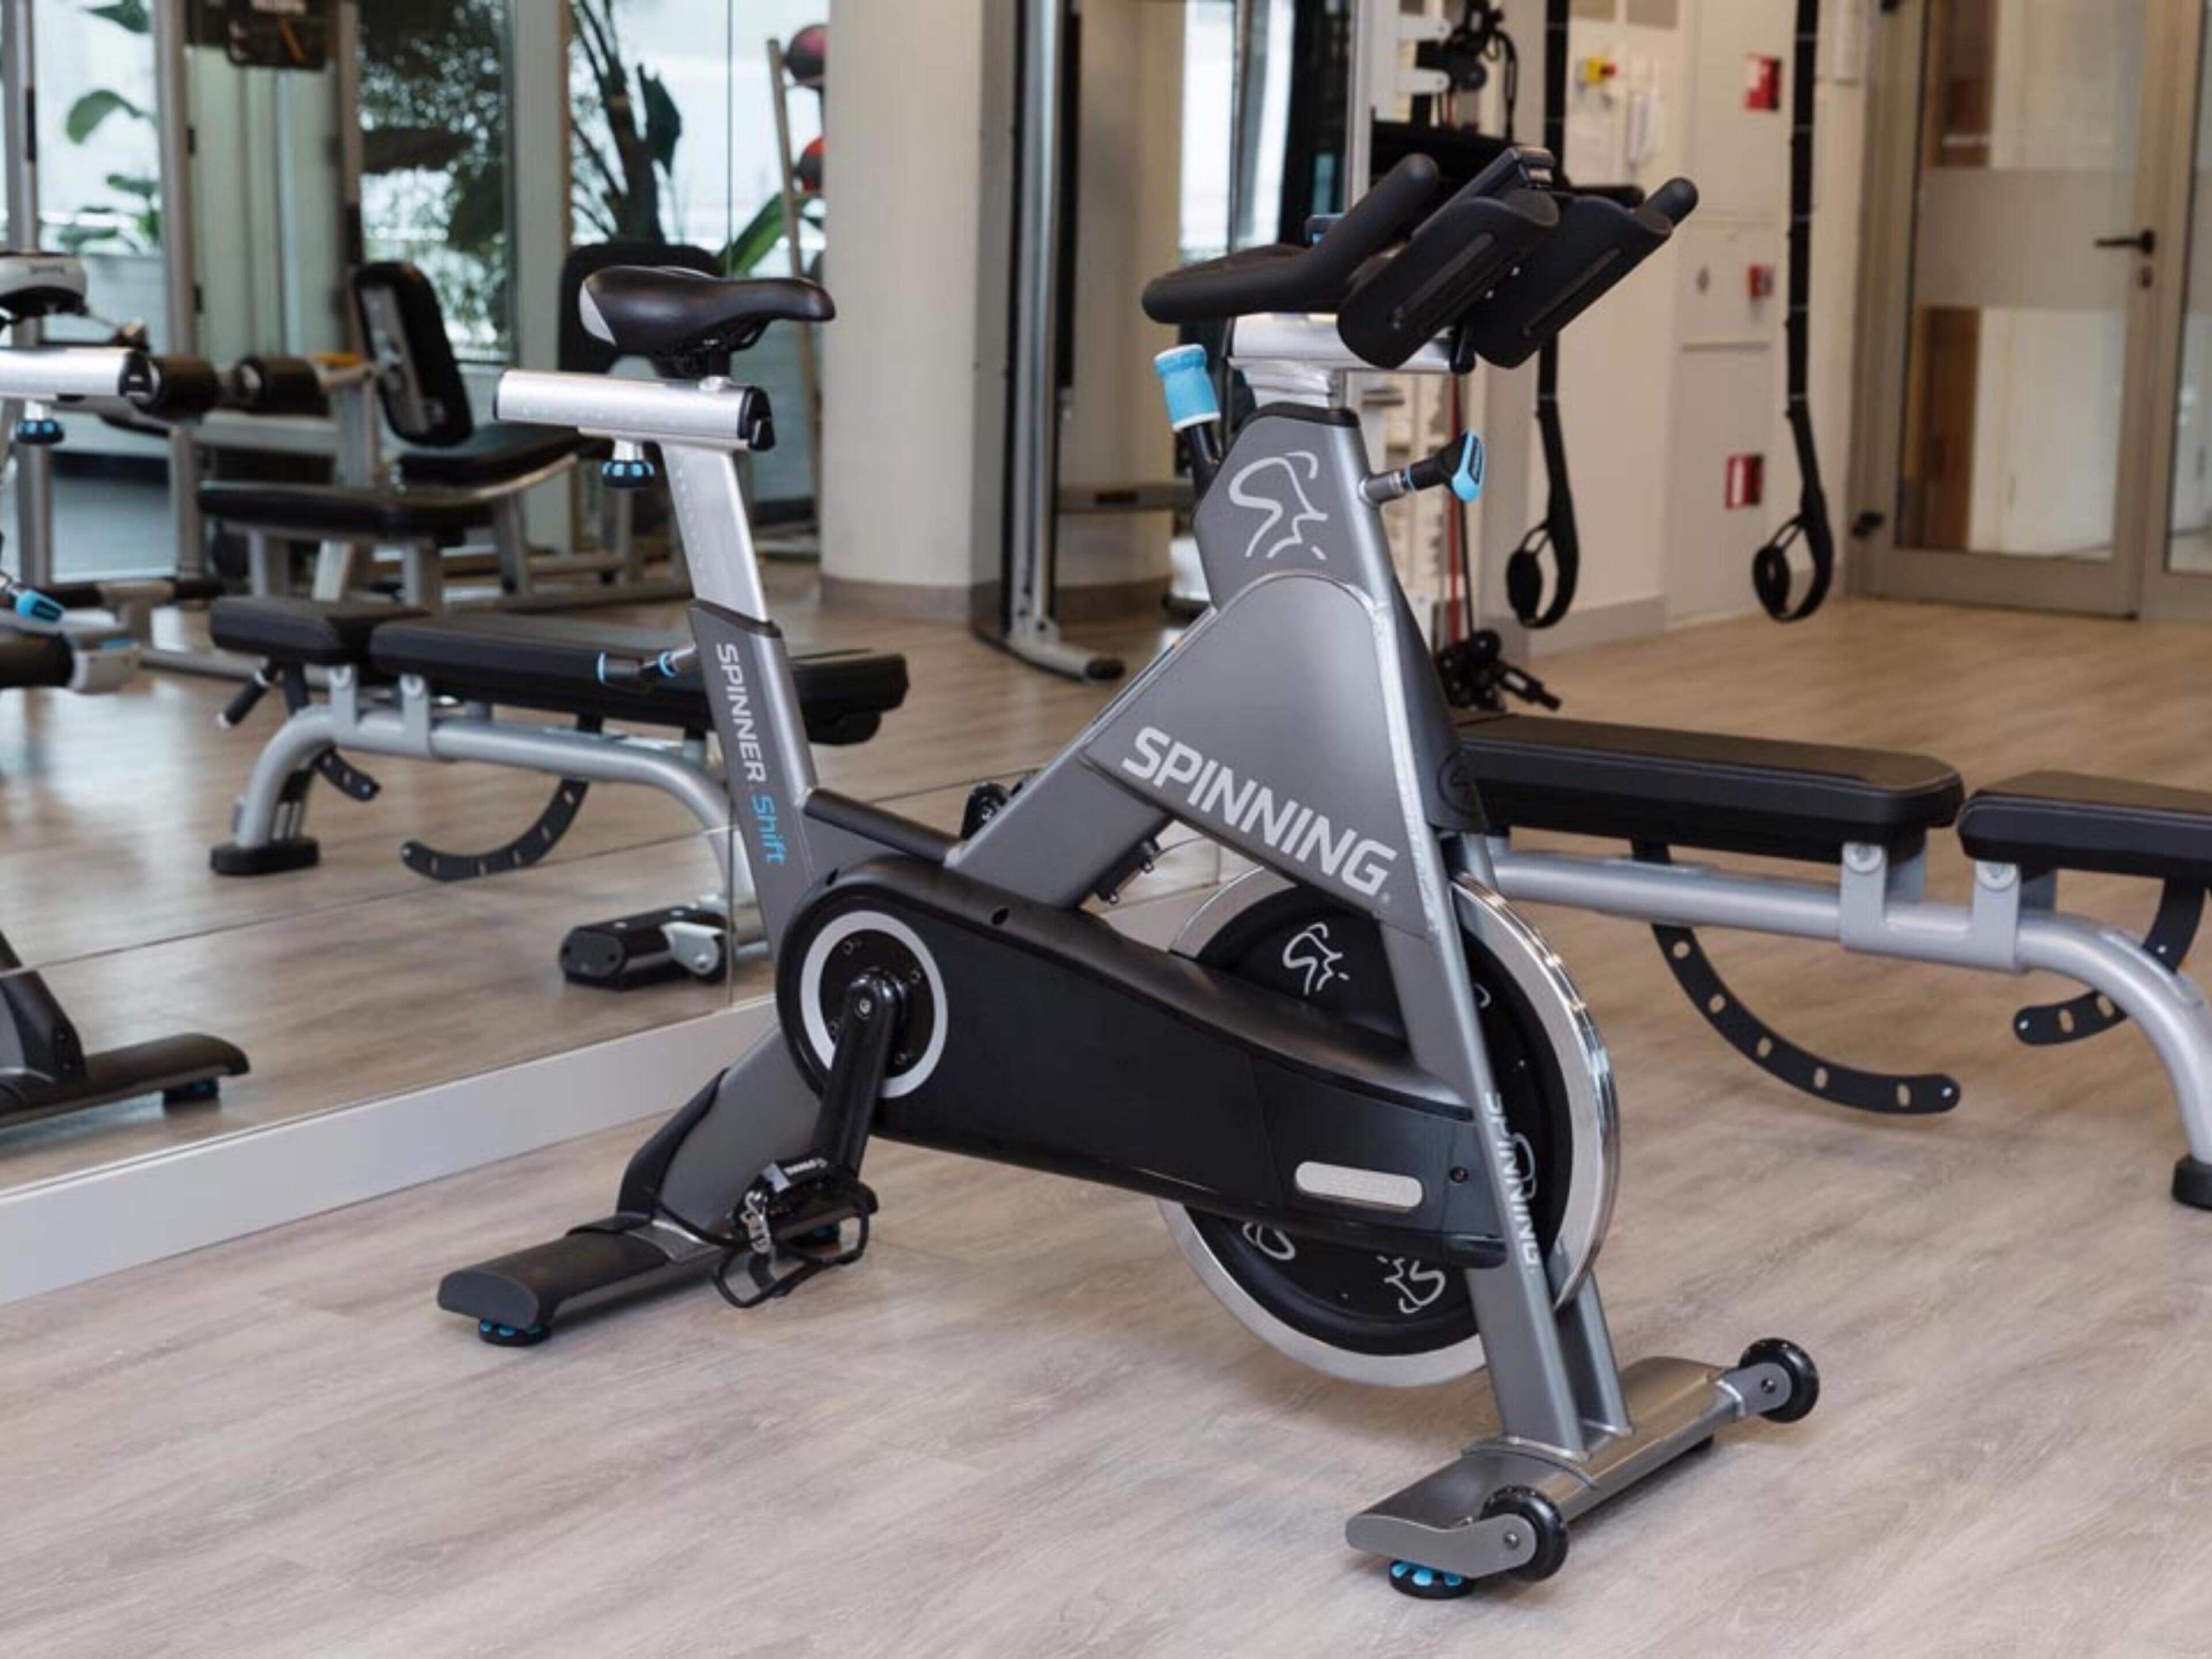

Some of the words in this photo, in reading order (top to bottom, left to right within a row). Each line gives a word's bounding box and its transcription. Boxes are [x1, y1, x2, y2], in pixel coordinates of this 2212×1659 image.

[716, 642, 766, 782] SPINNER
[752, 793, 787, 864] Shift
[1122, 726, 1397, 896] SPINNING
